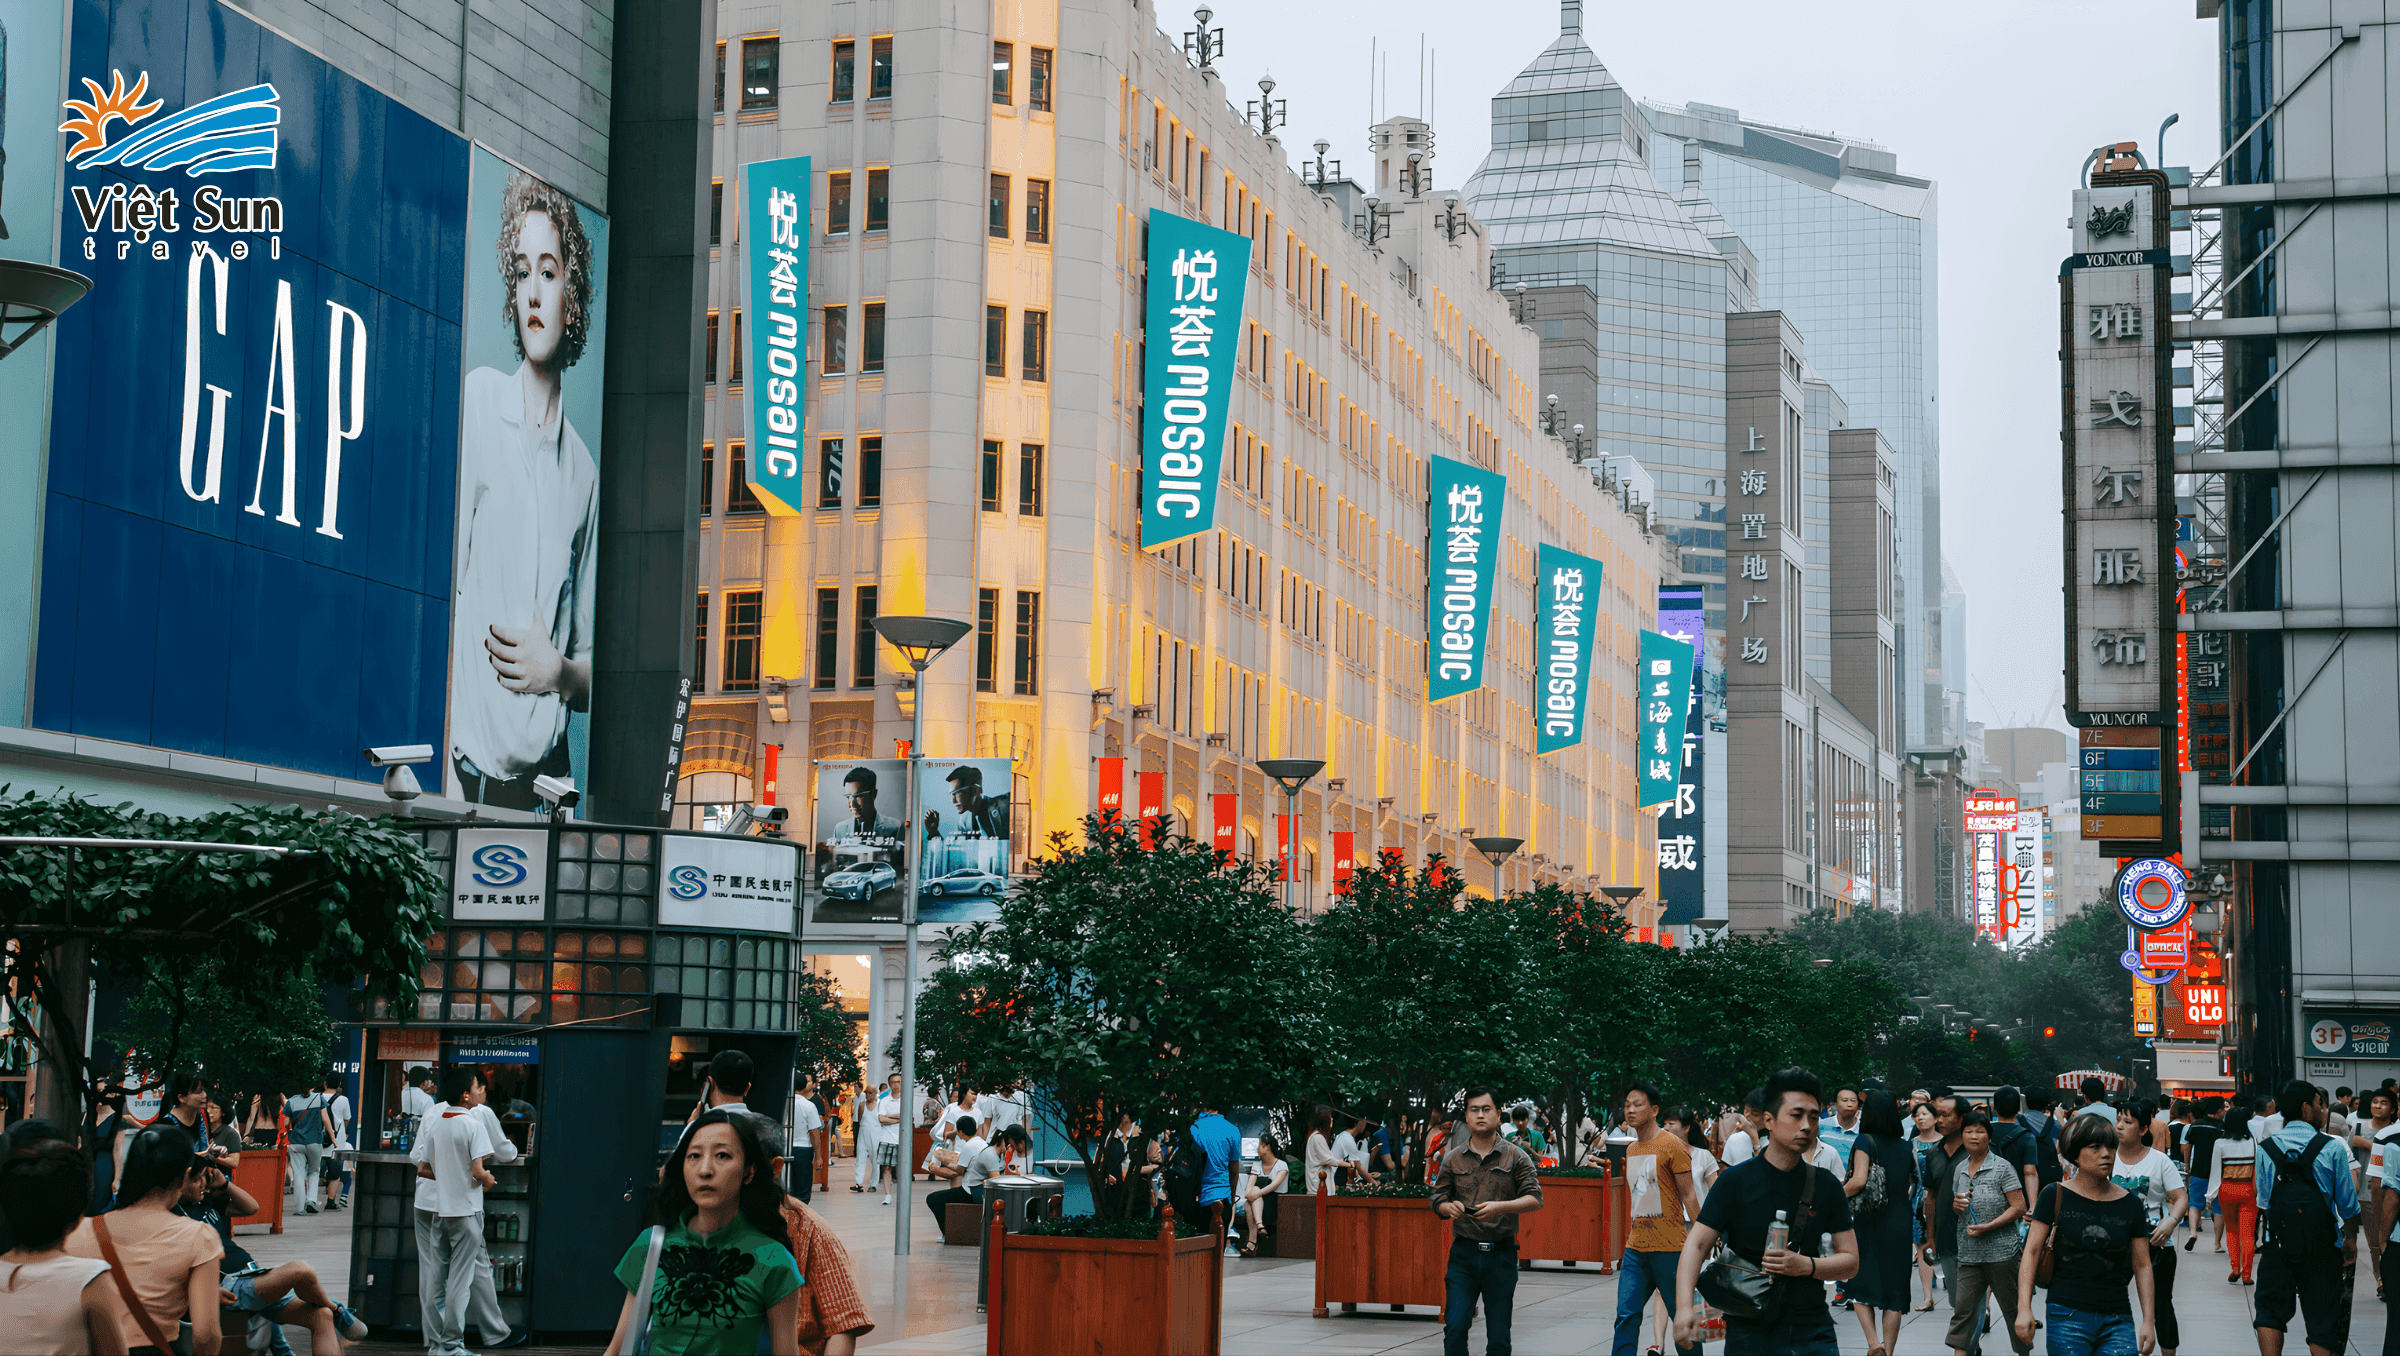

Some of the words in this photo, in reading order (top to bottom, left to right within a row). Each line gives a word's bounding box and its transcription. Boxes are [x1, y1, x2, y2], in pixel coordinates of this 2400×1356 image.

[767, 186, 799, 307] 悦荟
[1169, 249, 1218, 358] 悦荟
[179, 248, 367, 540] GAP
[766, 311, 798, 478] mosaic
[1157, 364, 1210, 519] mosaic
[2089, 302, 2146, 665] 雅戈尔服饰
[1446, 483, 1483, 564] 悦荟
[1740, 427, 1768, 665] 上海置地广场
[1439, 568, 1478, 681] mosaic
[1552, 568, 1583, 637] 悦荟
[1546, 640, 1578, 737] mosaic
[2085, 730, 2103, 743] 7F
[2085, 752, 2105, 765] 6F
[2085, 775, 2105, 787] 5F
[2086, 797, 2105, 810] 4F
[2086, 820, 2105, 832] 3F
[2147, 943, 2184, 952] OPTICAL
[2188, 989, 2219, 1004] UNI
[2188, 1006, 2222, 1023] QLO
[2315, 1027, 2343, 1044] 3F
